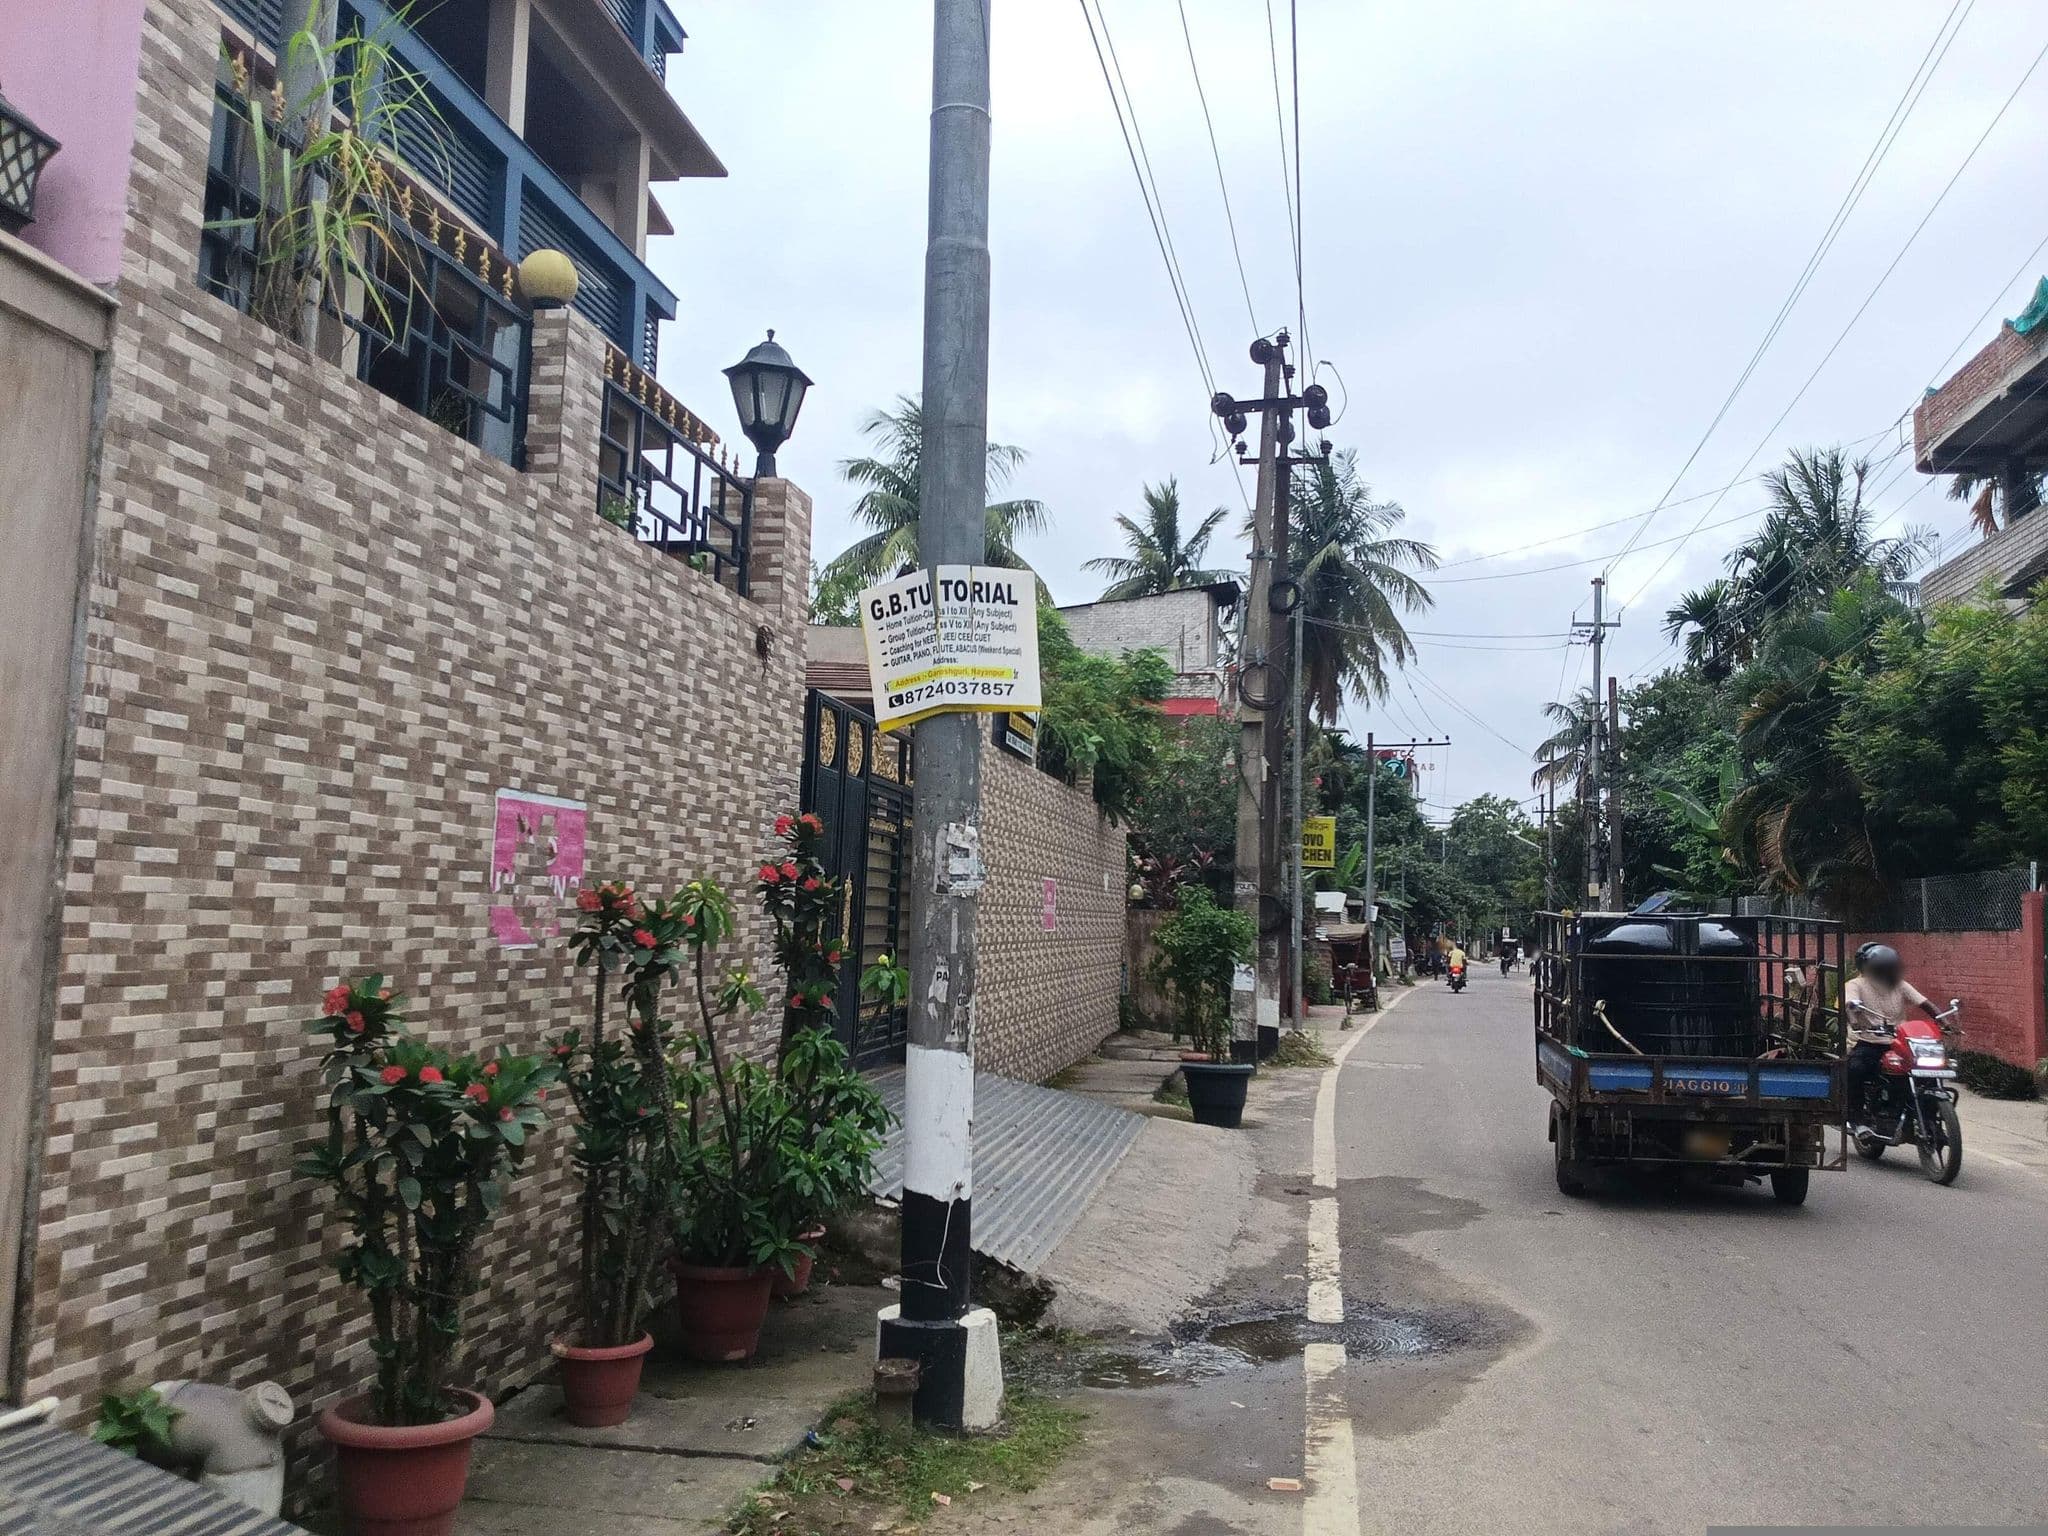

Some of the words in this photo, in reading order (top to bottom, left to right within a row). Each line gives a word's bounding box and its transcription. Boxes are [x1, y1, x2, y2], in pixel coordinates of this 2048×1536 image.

[886, 620, 902, 631] Home
[951, 606, 957, 615] to
[986, 608, 1013, 619] Subject)
[888, 633, 905, 643] Group
[949, 620, 954, 628] V
[955, 620, 962, 629] to
[990, 621, 1017, 633] Subject)
[889, 642, 914, 655] Coaching
[914, 639, 922, 647] for
[904, 681, 1015, 705] 8724037857
